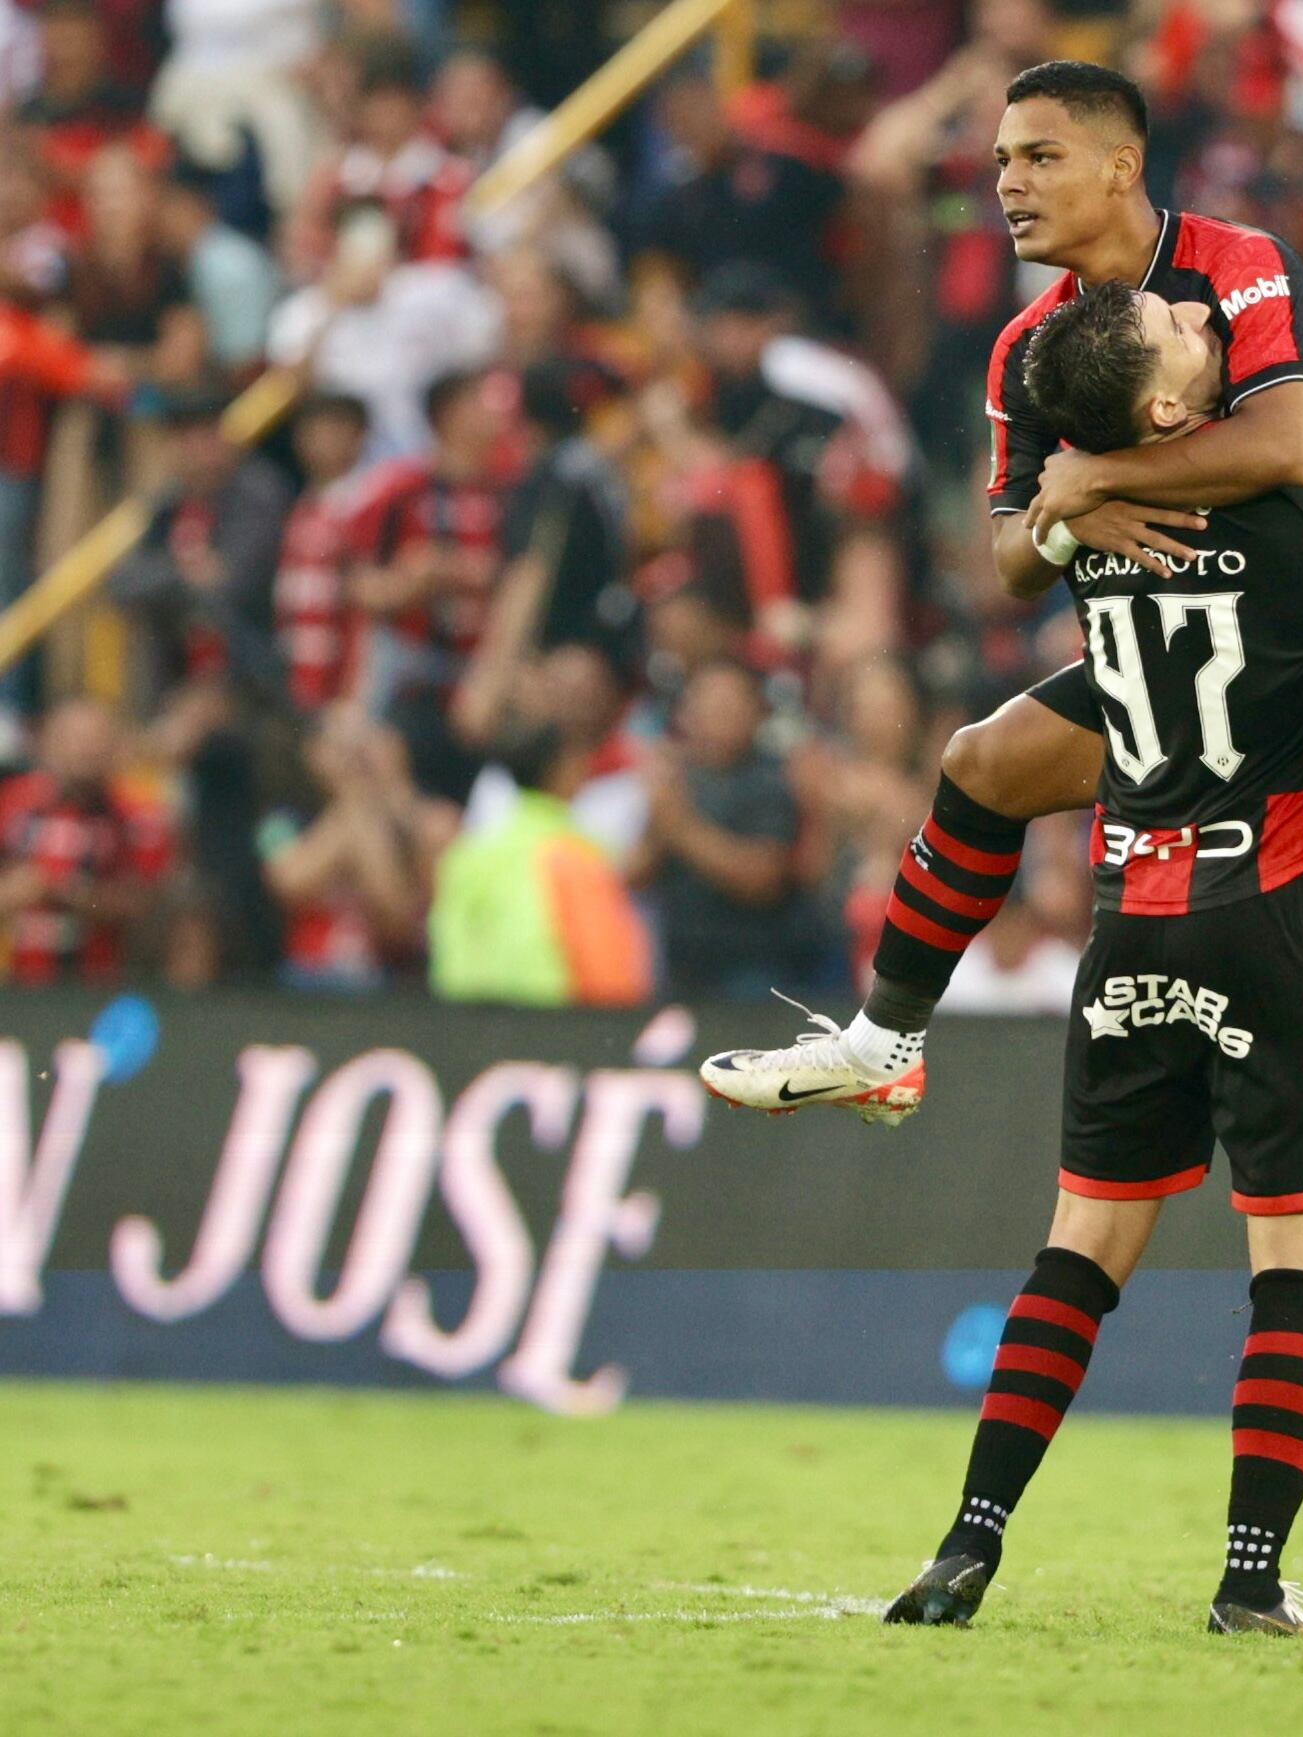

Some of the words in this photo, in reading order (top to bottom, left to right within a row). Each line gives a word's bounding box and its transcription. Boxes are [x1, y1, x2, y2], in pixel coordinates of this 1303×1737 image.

[1219, 274, 1291, 321] Mobil
[1083, 591, 1246, 786] 97
[1103, 973, 1230, 1024] STAR
[1130, 997, 1254, 1060] CARS
[109, 1005, 707, 1420] JOSÉ
